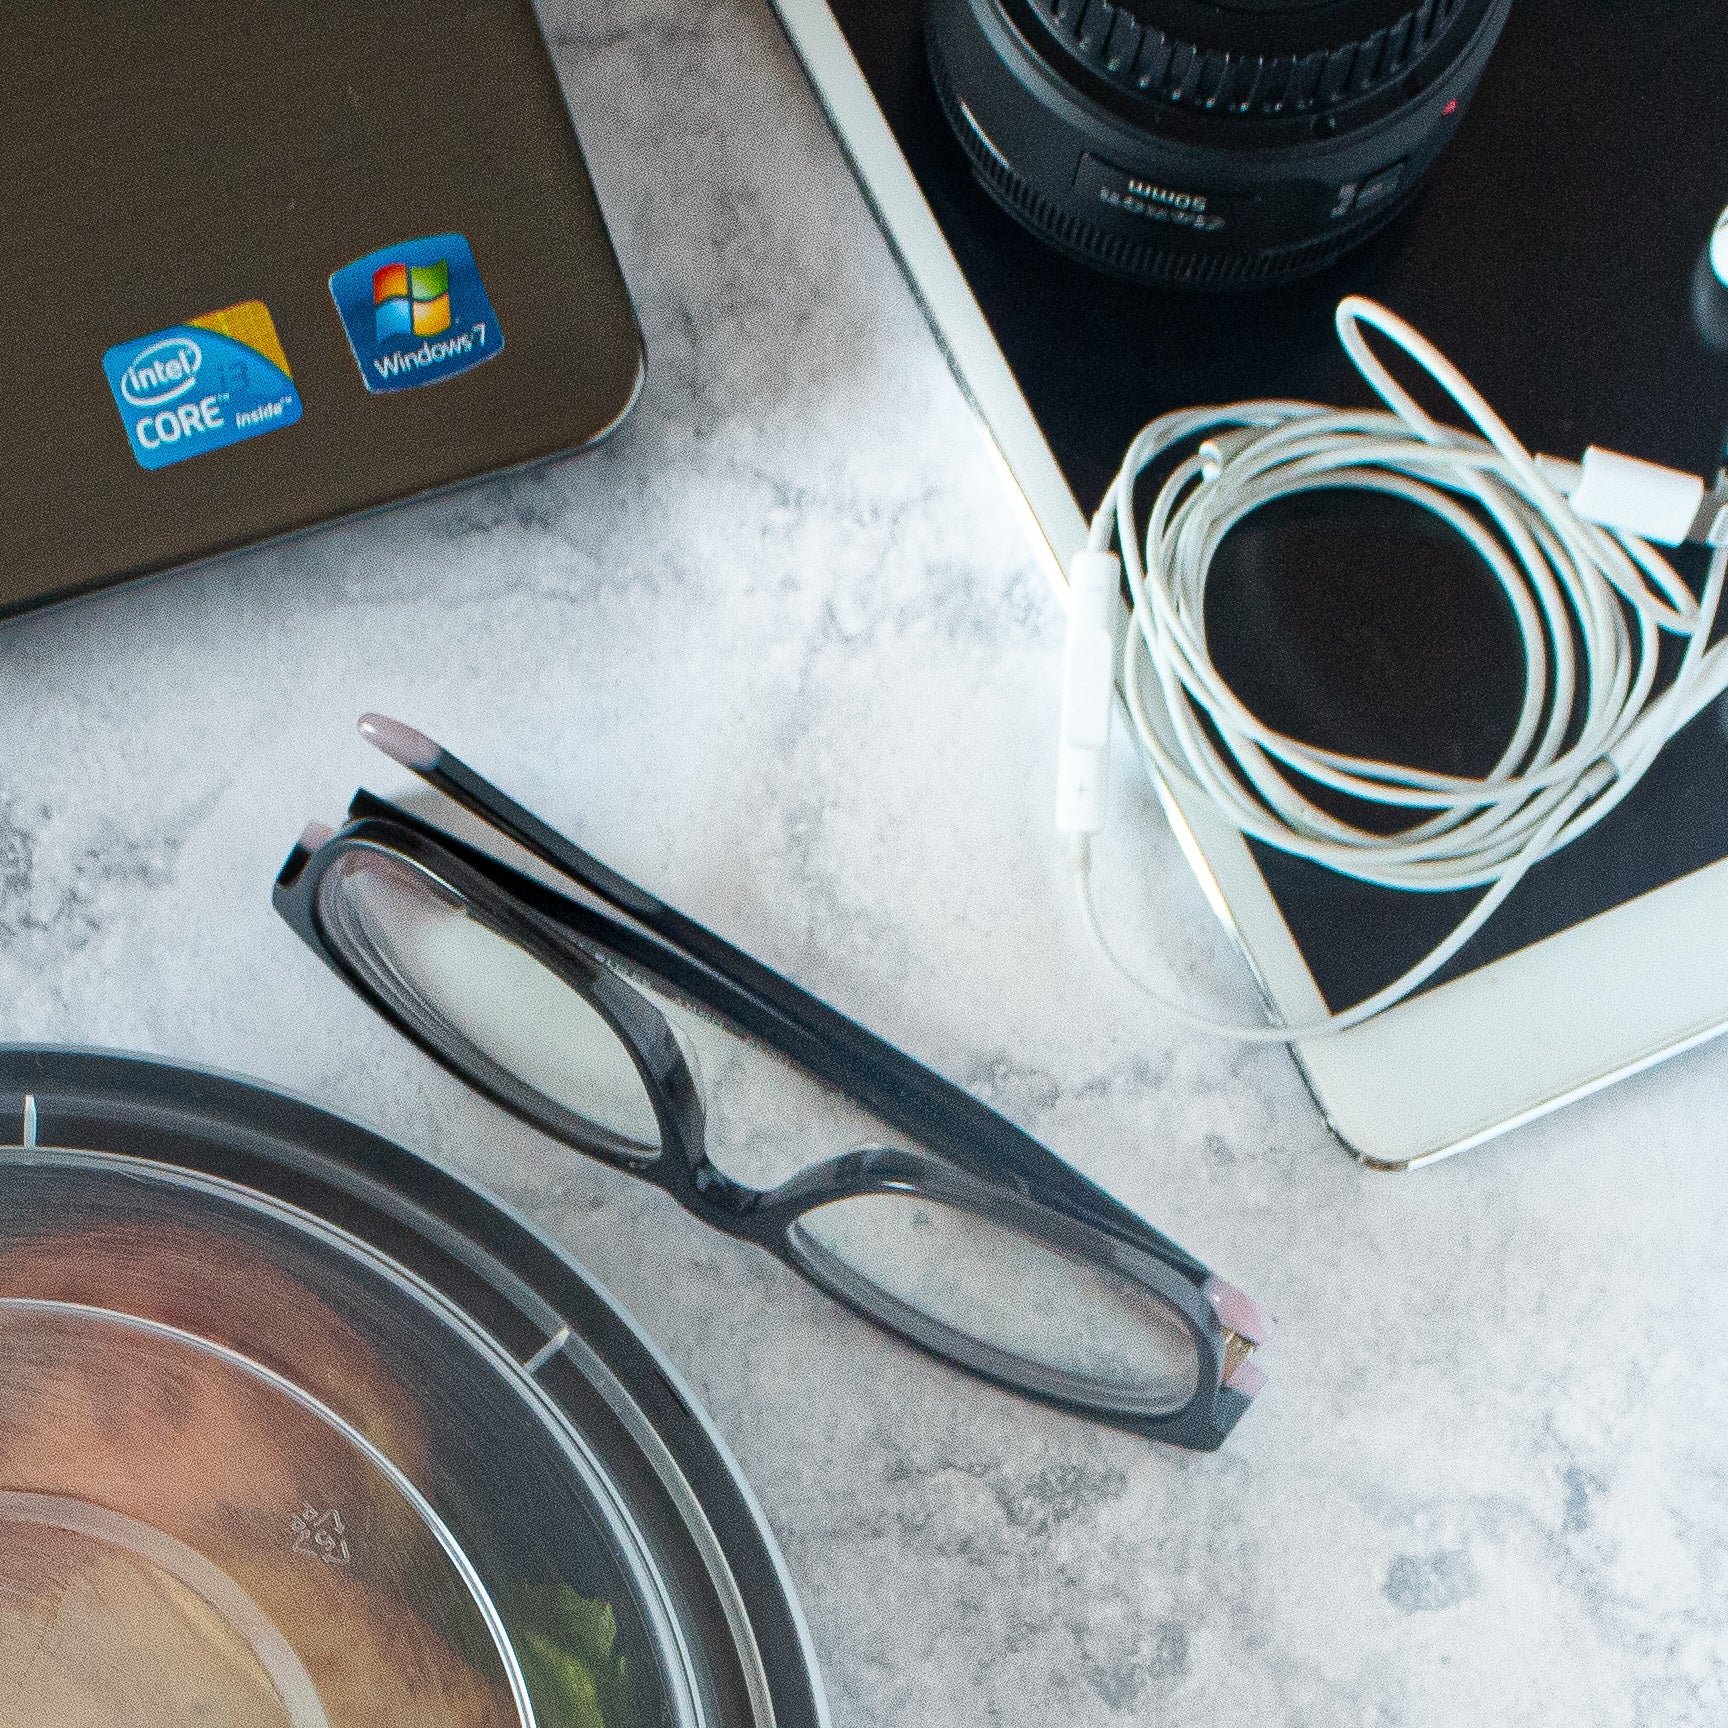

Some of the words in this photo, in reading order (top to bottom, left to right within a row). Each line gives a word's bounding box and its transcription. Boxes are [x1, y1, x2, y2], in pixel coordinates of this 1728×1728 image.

[1130, 180, 1207, 212] 50mm
[373, 334, 471, 379] Windows
[470, 324, 488, 348] 7
